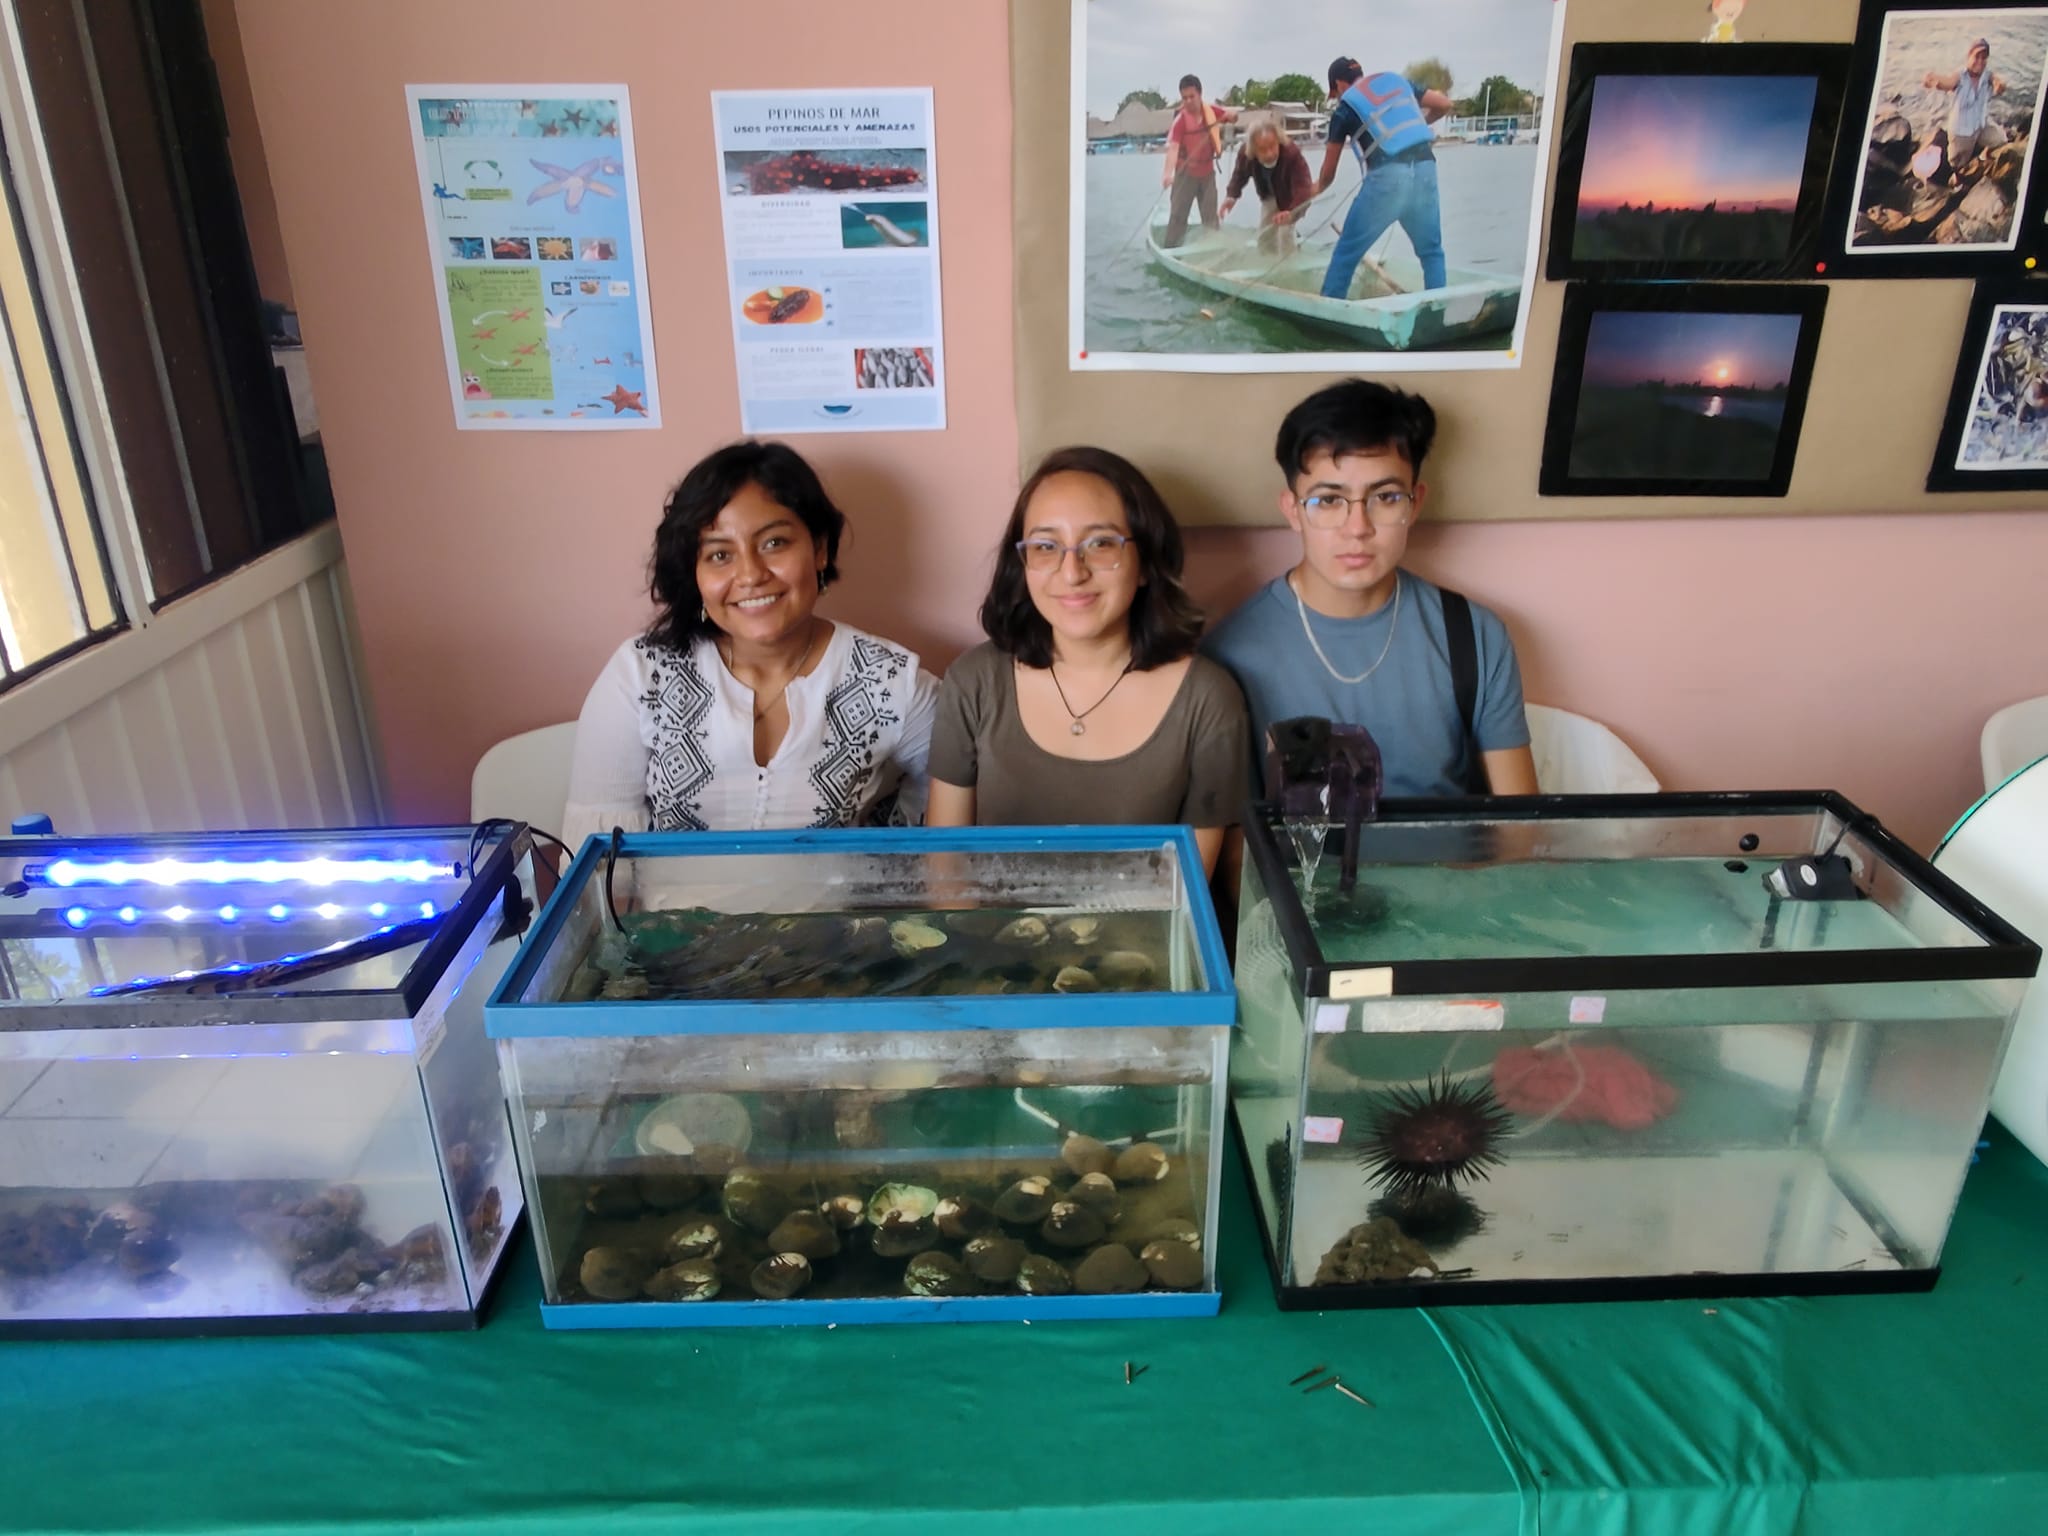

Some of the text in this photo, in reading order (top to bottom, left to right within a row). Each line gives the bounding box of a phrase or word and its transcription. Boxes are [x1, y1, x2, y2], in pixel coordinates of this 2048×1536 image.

[768, 107, 880, 120] PEPINOS DE MAR
[734, 123, 916, 133] USOS POTENCIALES Y AMENAZAS
